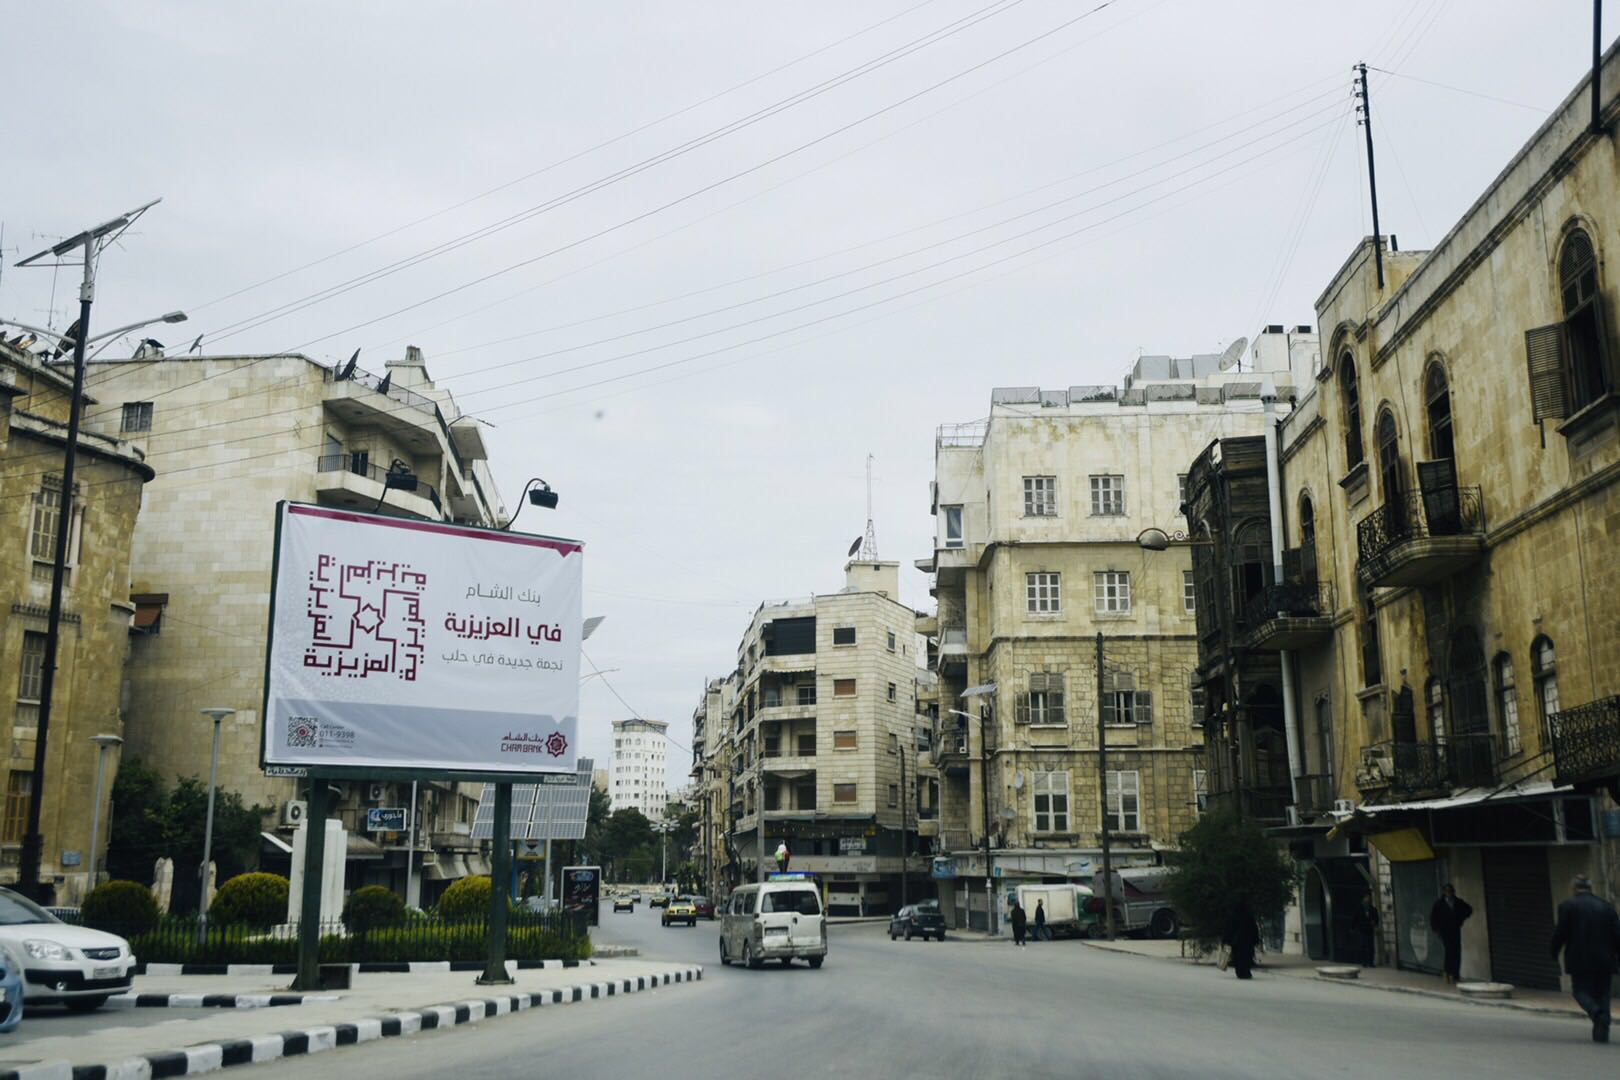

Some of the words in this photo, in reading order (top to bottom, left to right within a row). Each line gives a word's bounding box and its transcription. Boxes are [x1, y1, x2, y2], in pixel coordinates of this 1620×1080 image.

[465, 583, 513, 600] الشام
[517, 588, 541, 607] بنك
[444, 612, 520, 641] العزيزية
[527, 623, 562, 646] في
[441, 648, 469, 664] حلب
[472, 652, 495, 666] في
[497, 654, 533, 670] جديدة
[536, 657, 563, 672] نجمة
